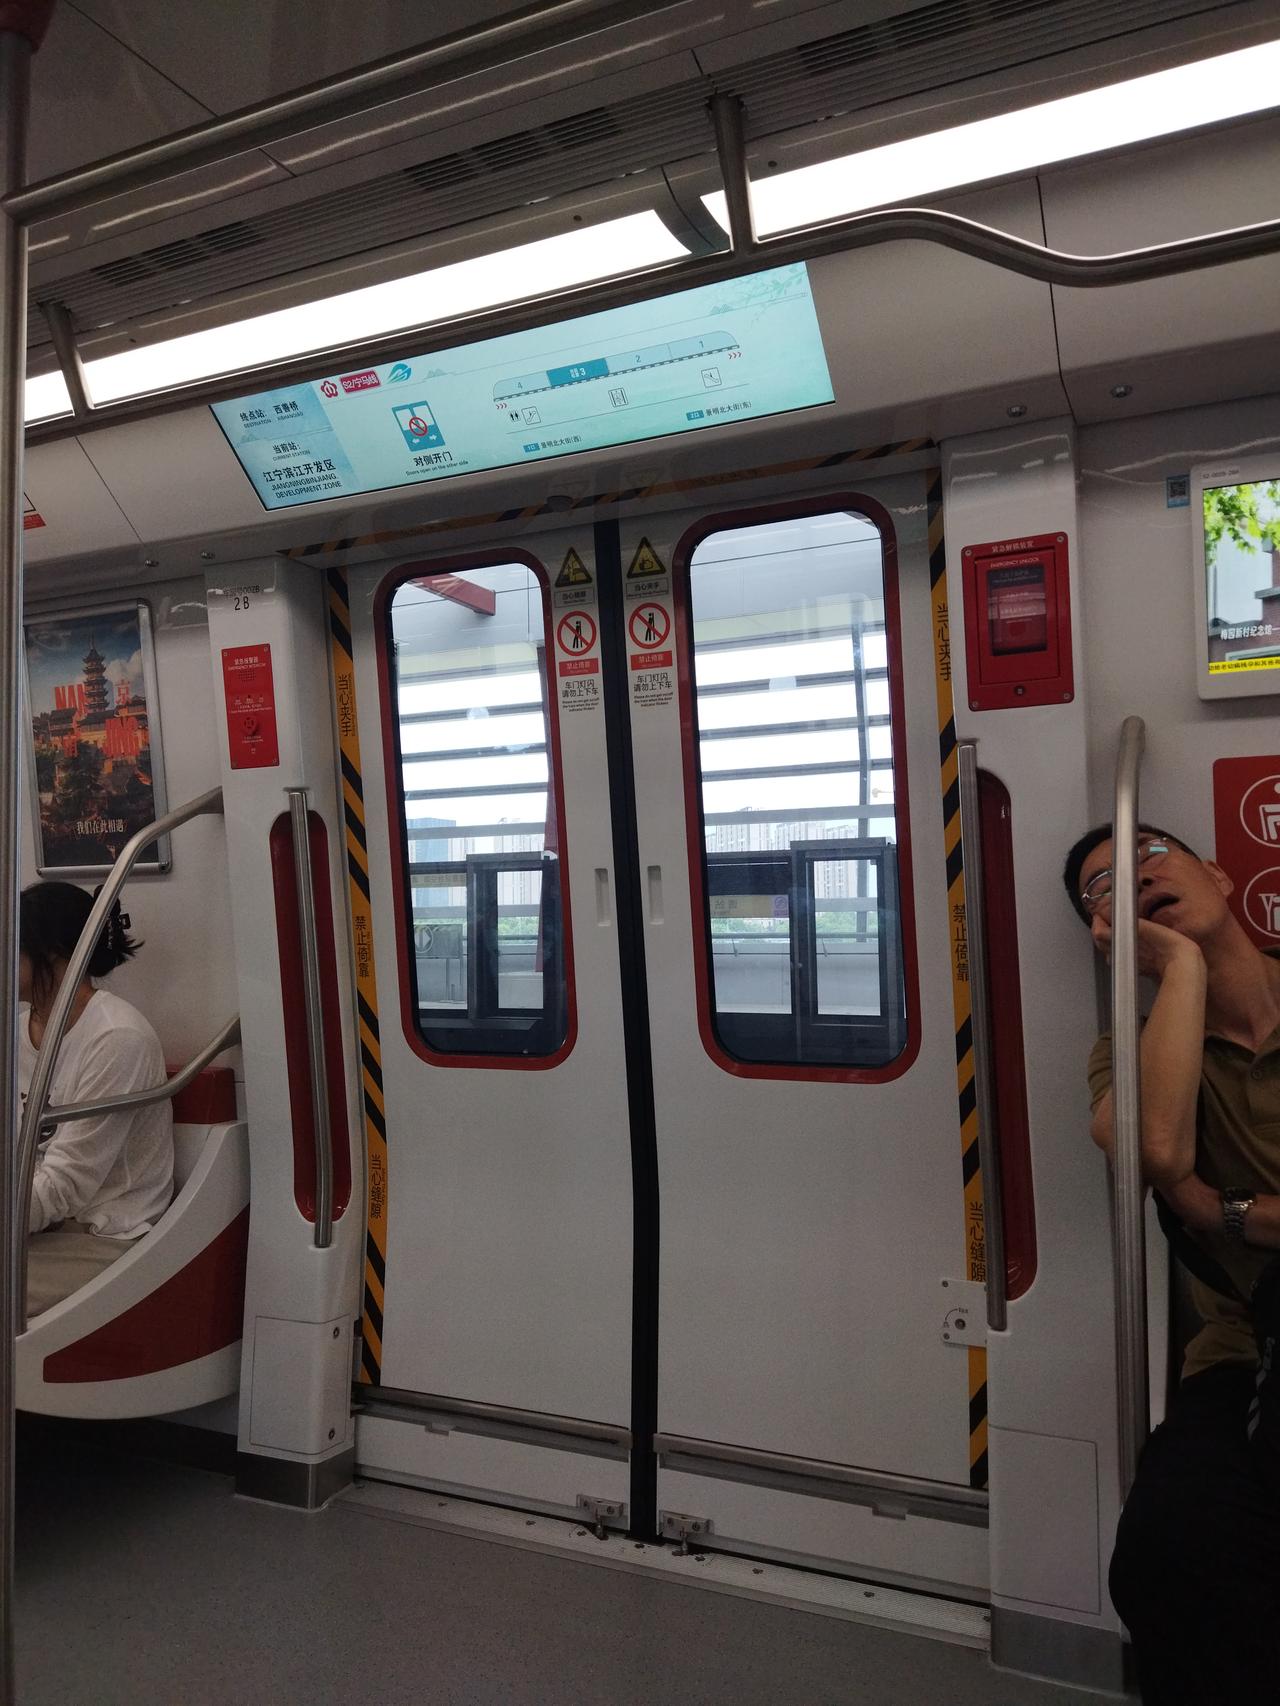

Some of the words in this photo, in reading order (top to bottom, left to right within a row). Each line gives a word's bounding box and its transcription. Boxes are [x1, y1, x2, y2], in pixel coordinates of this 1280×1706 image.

[579, 367, 586, 377] 3
[412, 451, 453, 467] 对侧开门
[263, 459, 336, 482] 江宁滨江开发区
[271, 473, 337, 491] JIANGNINGBINJIANG
[275, 483, 323, 499] DEVELOPMENT
[323, 480, 342, 490] ZONE
[937, 602, 952, 681] 当心夹手
[564, 679, 595, 690] 车门灯闪
[636, 672, 669, 684] 车门灯闪
[561, 687, 599, 698] 请勿上下车
[633, 681, 673, 693] 请勿上下车
[339, 673, 352, 736] 当心夹手
[969, 1200, 986, 1283] 当心缝隙
